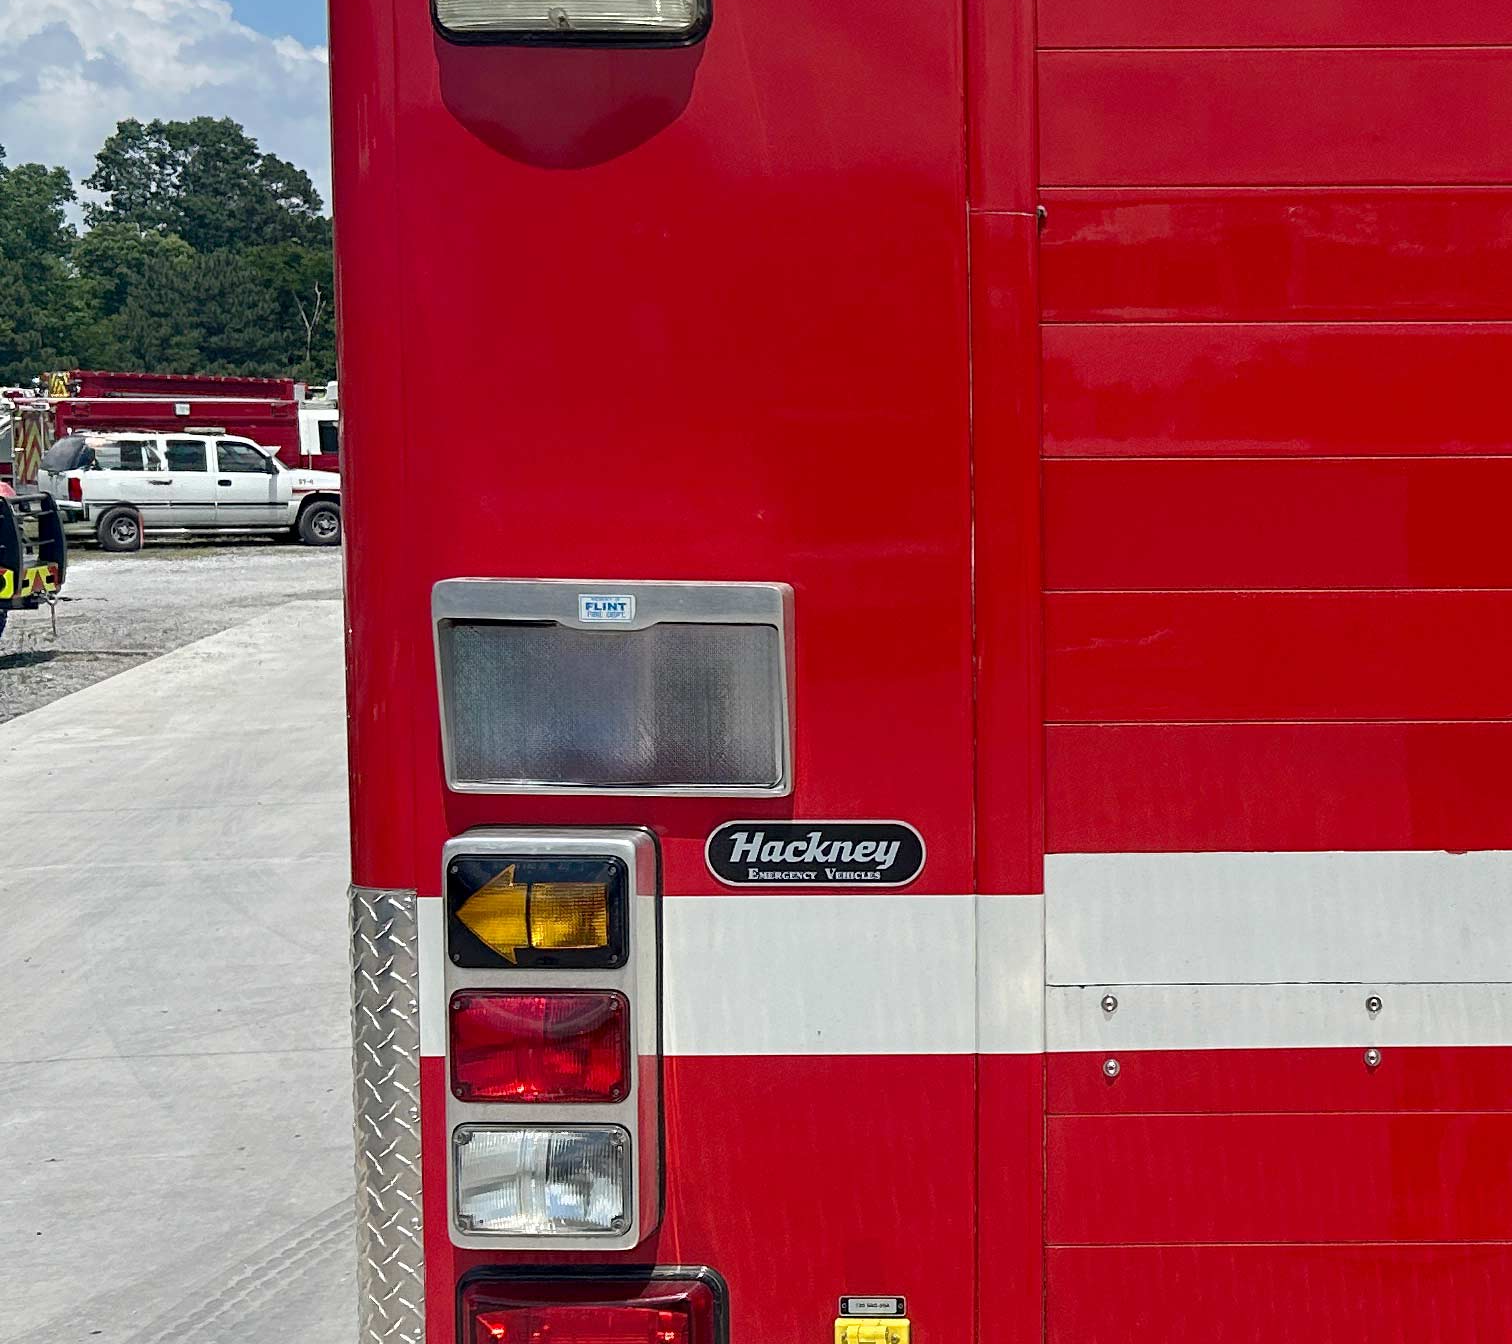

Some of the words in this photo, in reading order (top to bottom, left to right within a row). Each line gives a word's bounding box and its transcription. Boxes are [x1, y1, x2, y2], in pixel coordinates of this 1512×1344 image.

[585, 602, 627, 611] FLINT
[729, 831, 901, 870] Hackney
[748, 868, 818, 880] EMERGENCY
[824, 868, 881, 880] VEHICLES
